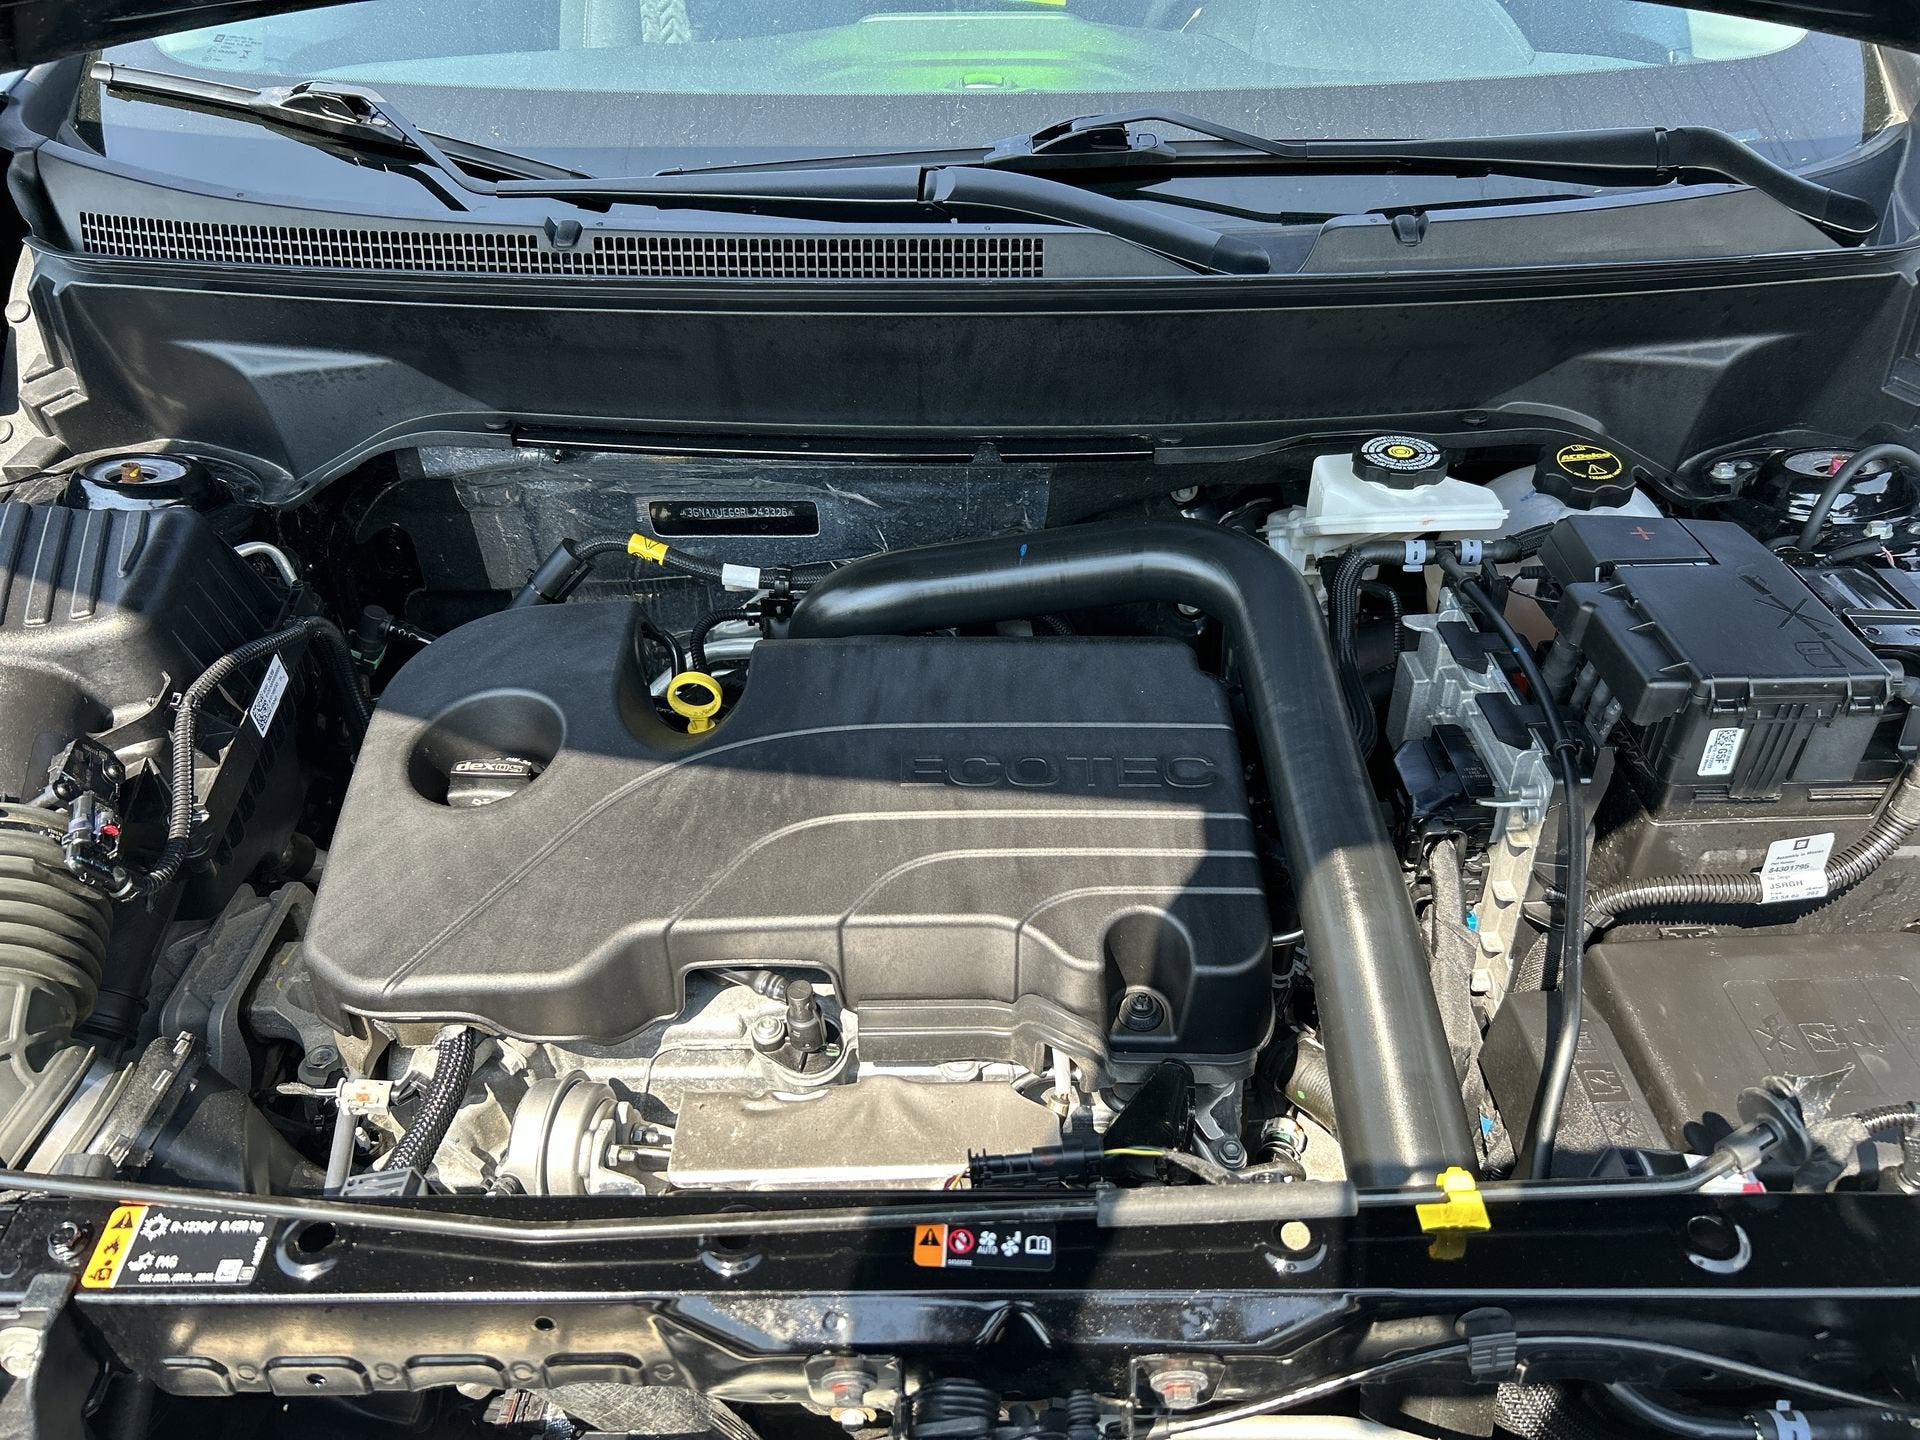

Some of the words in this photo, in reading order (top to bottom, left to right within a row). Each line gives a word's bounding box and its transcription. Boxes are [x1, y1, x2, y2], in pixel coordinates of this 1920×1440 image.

[455, 761, 524, 772] dexos
[900, 756, 1217, 788] ECOTEC
[976, 1245, 998, 1255] AUTO
